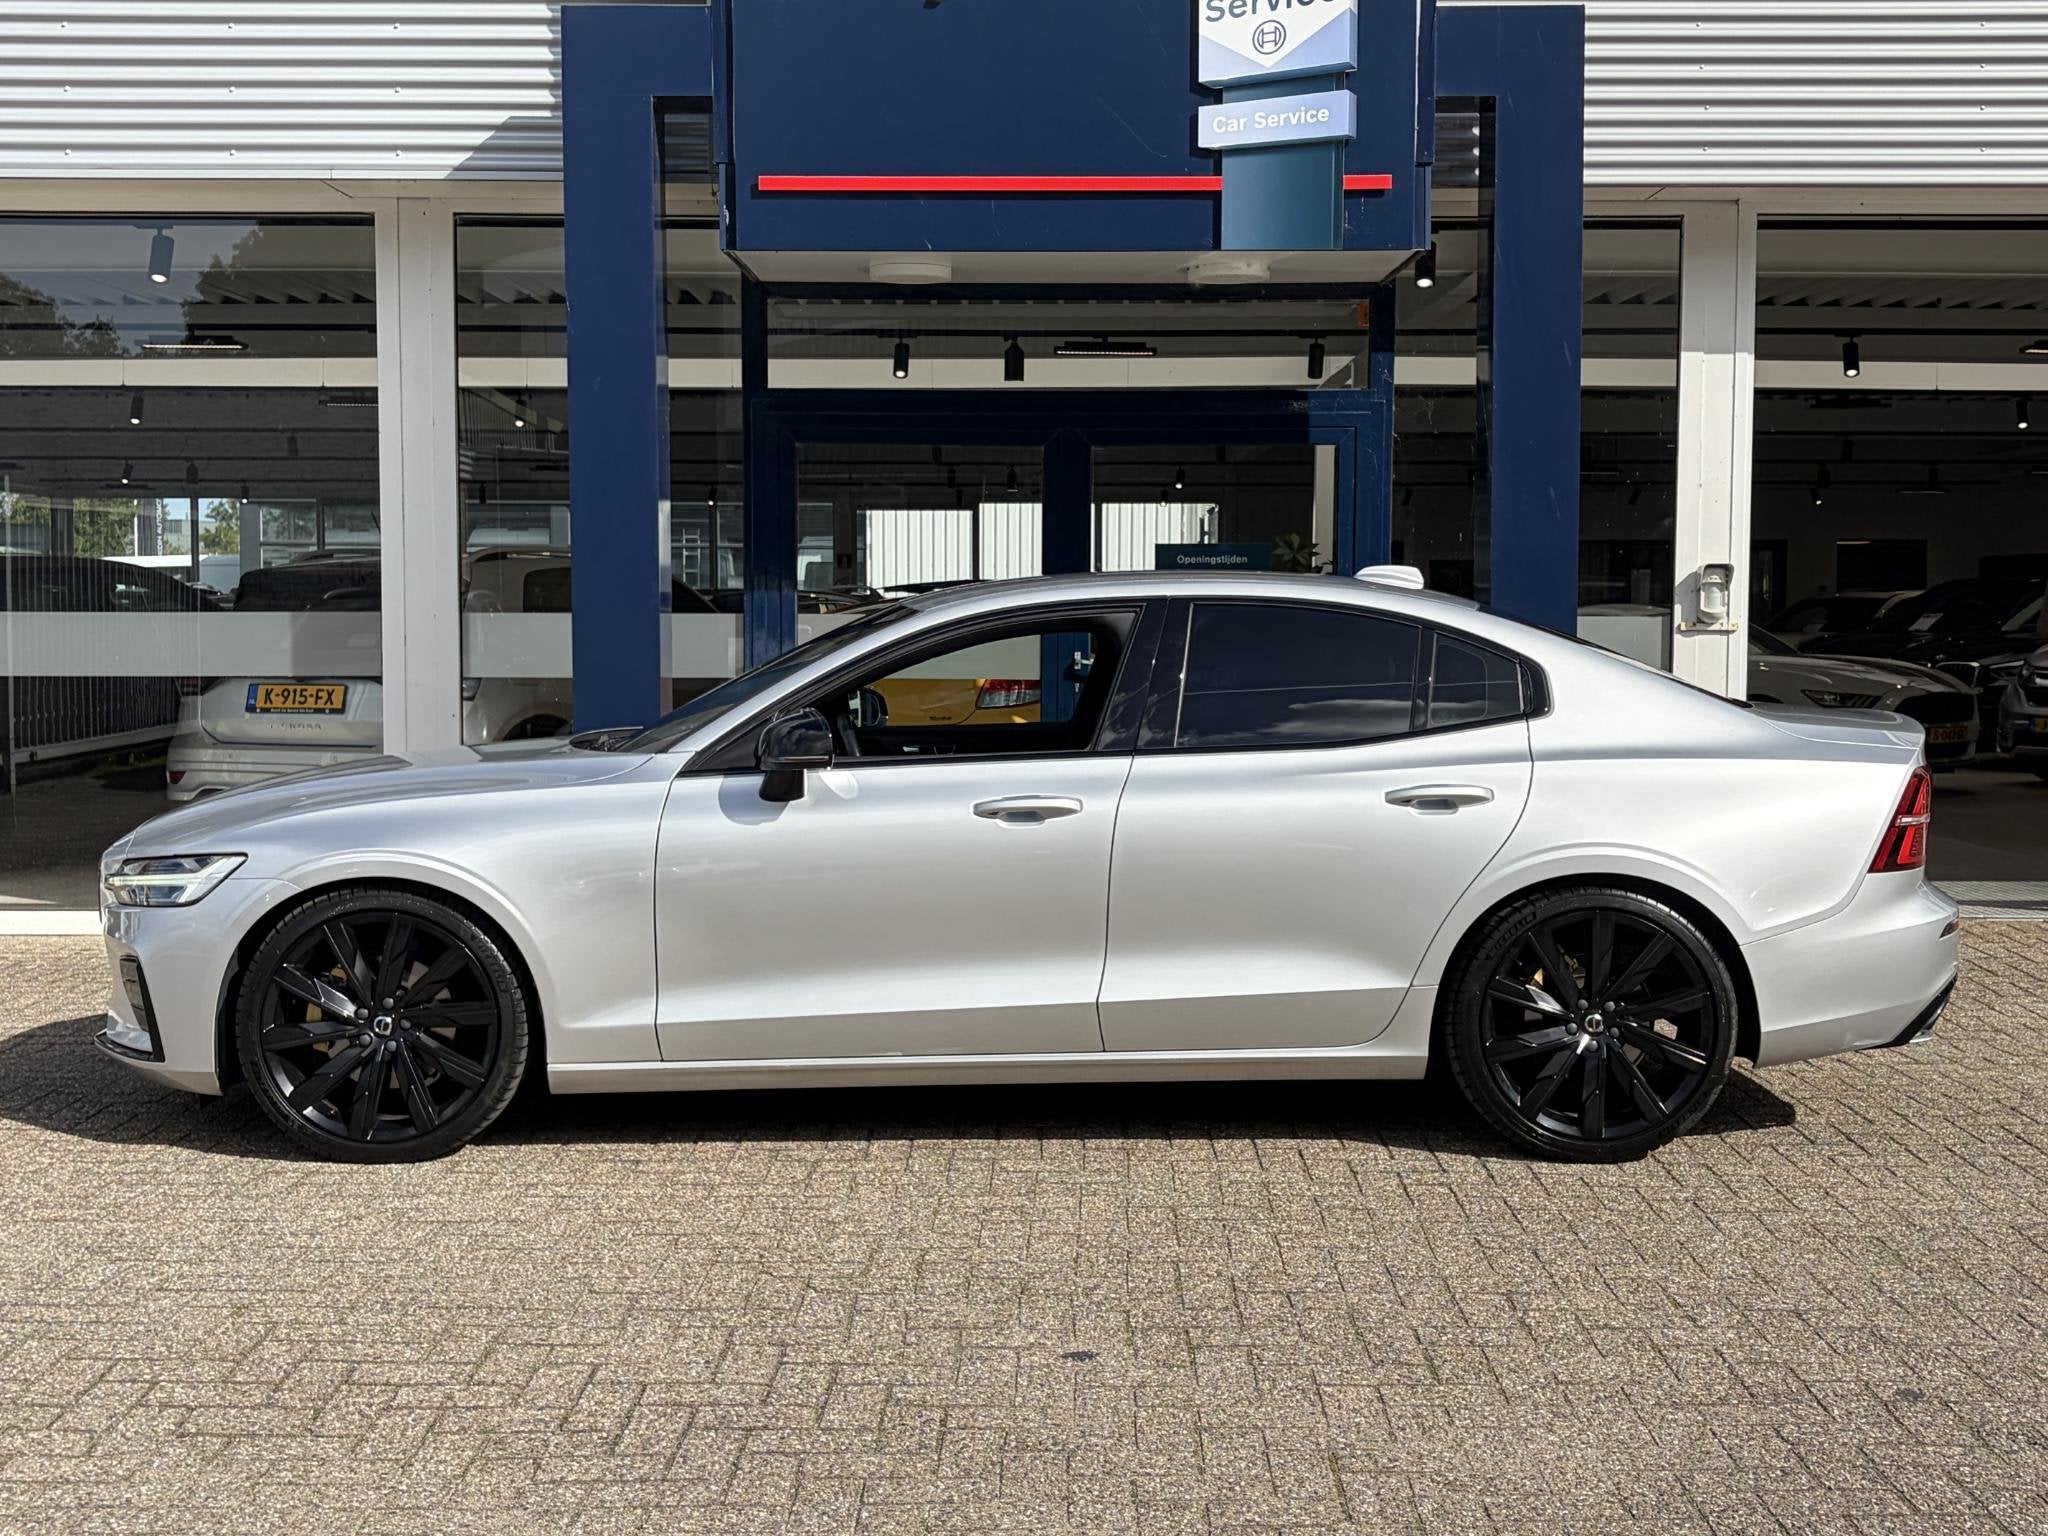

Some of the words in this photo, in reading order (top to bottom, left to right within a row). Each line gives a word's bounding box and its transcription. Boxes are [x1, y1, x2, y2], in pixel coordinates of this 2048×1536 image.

[1205, 0, 1334, 22] Serv
[1212, 116, 1247, 133] Car
[1254, 107, 1330, 129] Service
[1176, 554, 1248, 565] Openingstijden
[264, 687, 335, 706] K-915-FX
